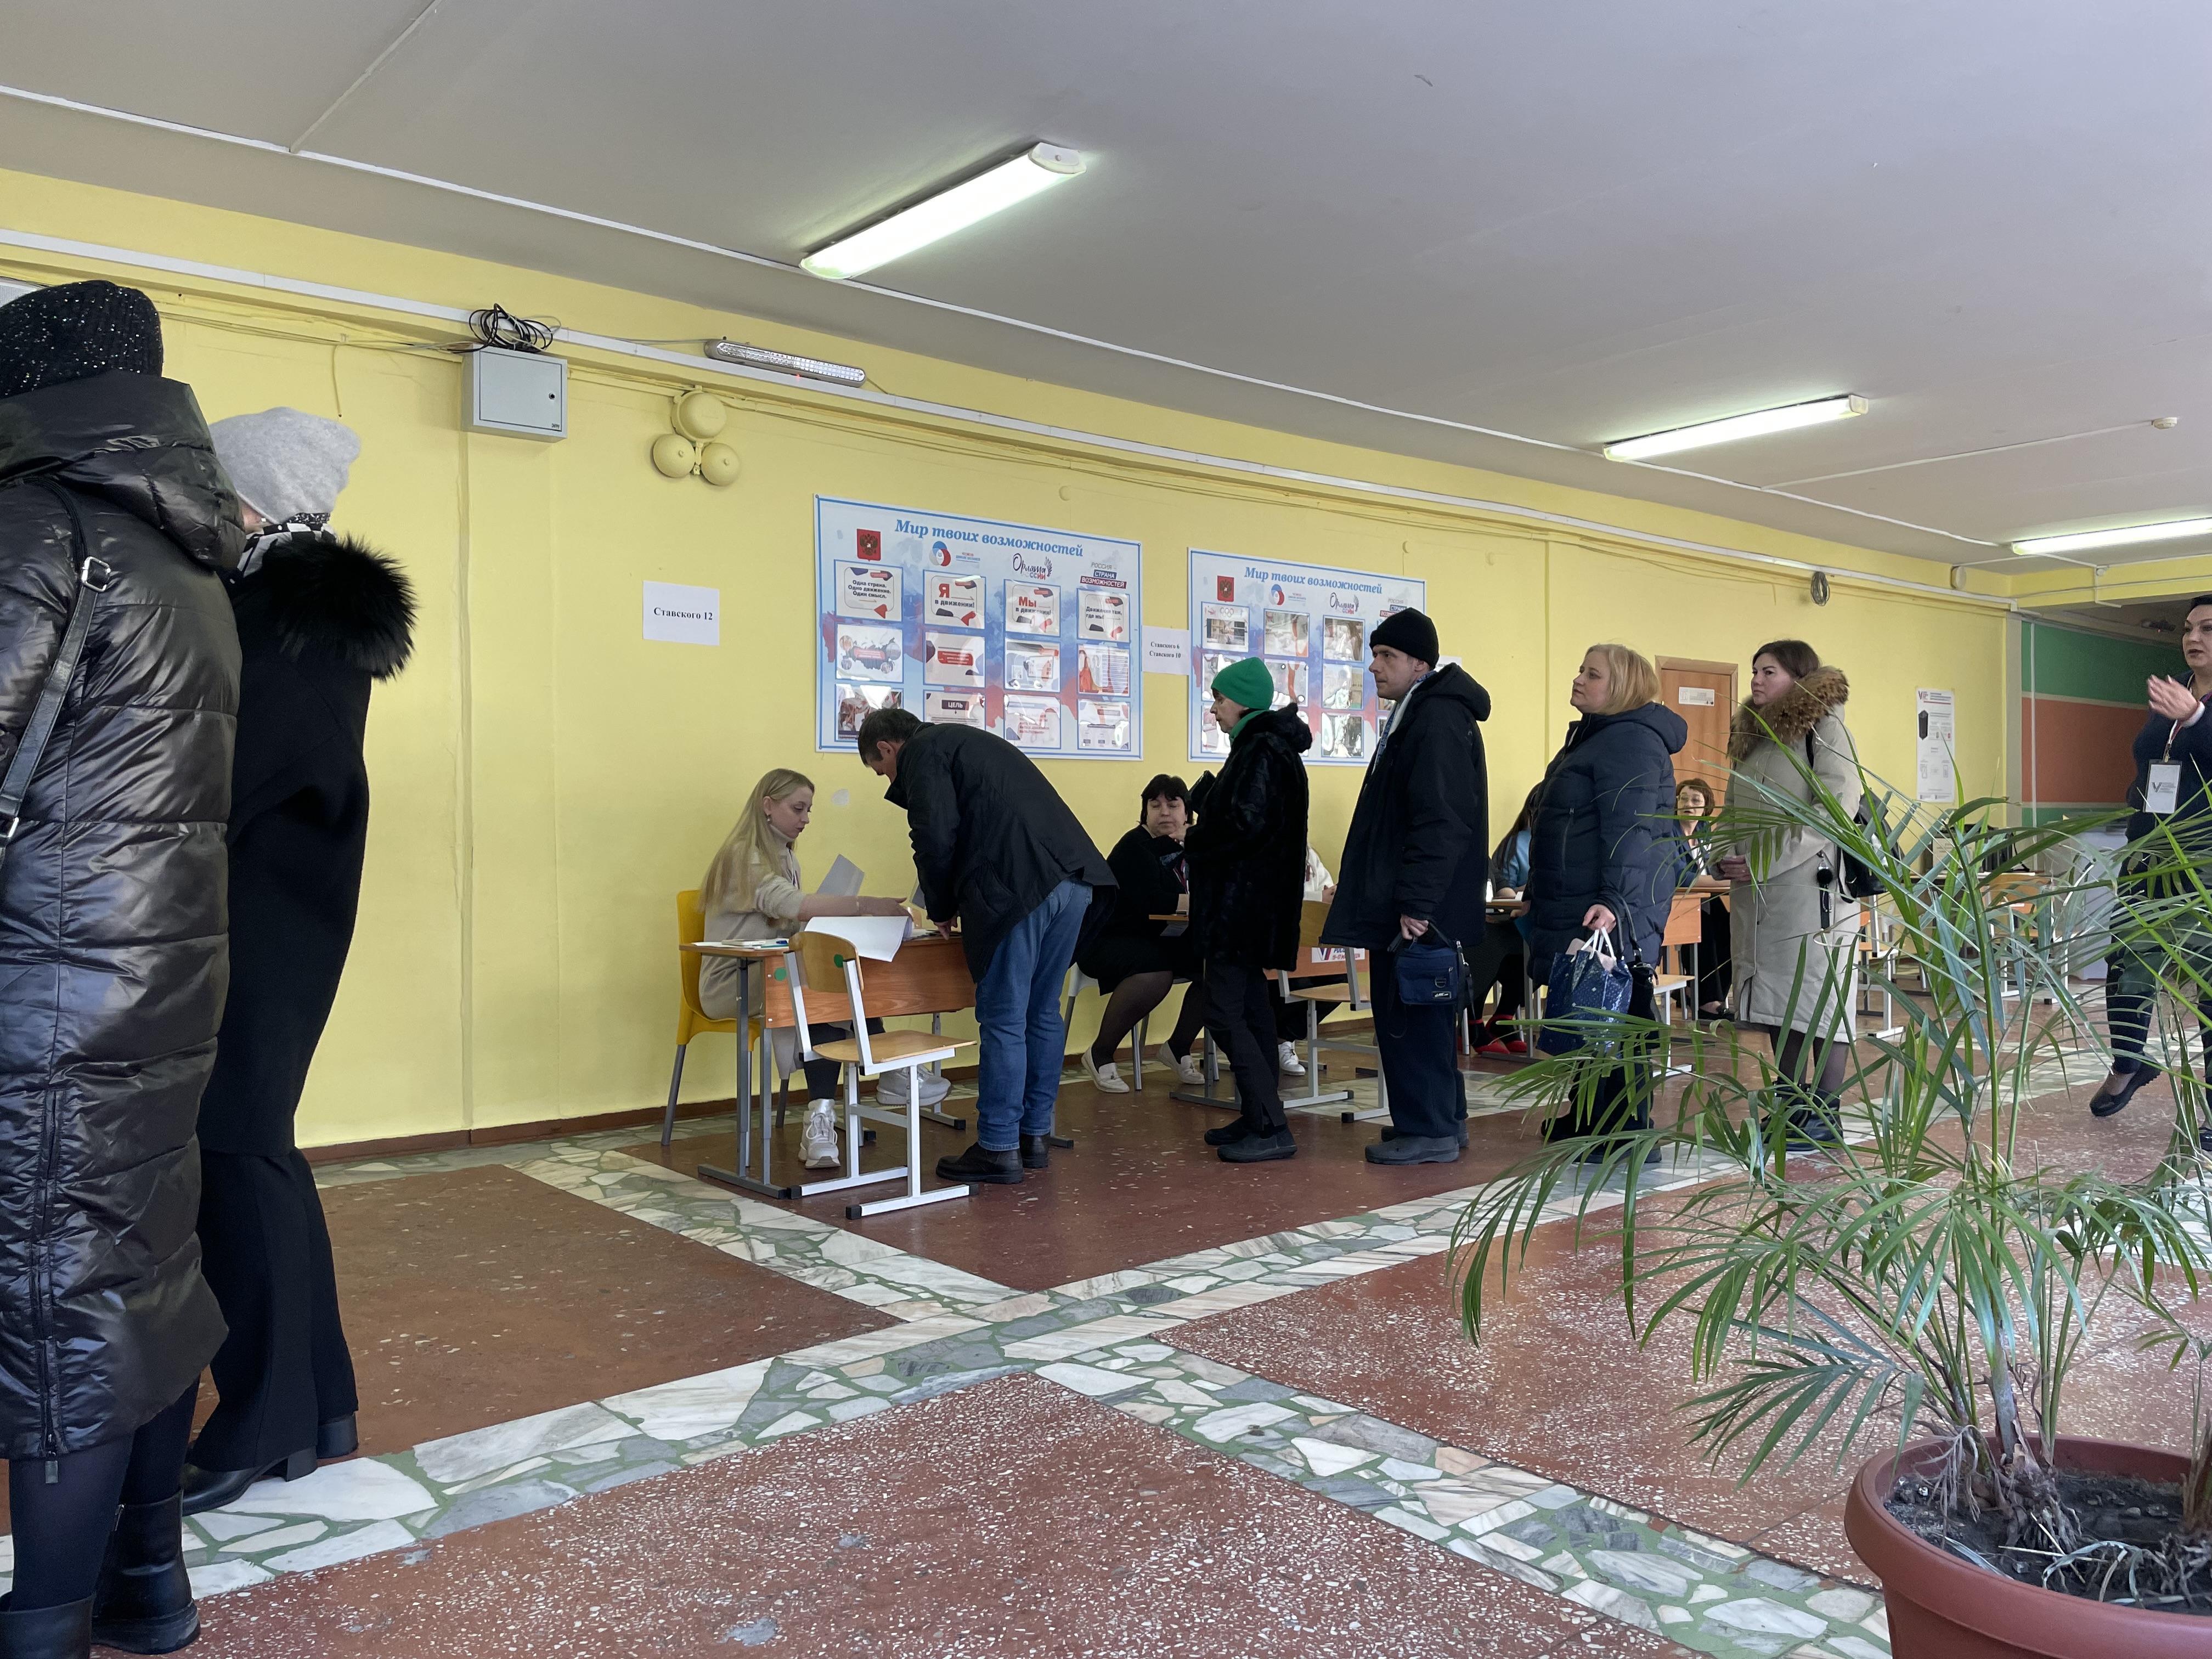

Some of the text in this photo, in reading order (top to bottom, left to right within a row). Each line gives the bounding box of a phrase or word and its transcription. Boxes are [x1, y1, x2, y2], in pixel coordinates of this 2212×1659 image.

[895, 519, 1084, 557] Мир твоих возможностей
[1091, 562, 1112, 570] РОССИЯ
[1094, 571, 1115, 579] СТРАНА
[1244, 567, 1383, 594] Мир твоих возможностей
[1081, 577, 1125, 588] ВОЗМОЖНОСТЕЙ
[939, 583, 950, 598] Я
[1019, 596, 1036, 607] Мы
[653, 607, 713, 620] Ставского 12
